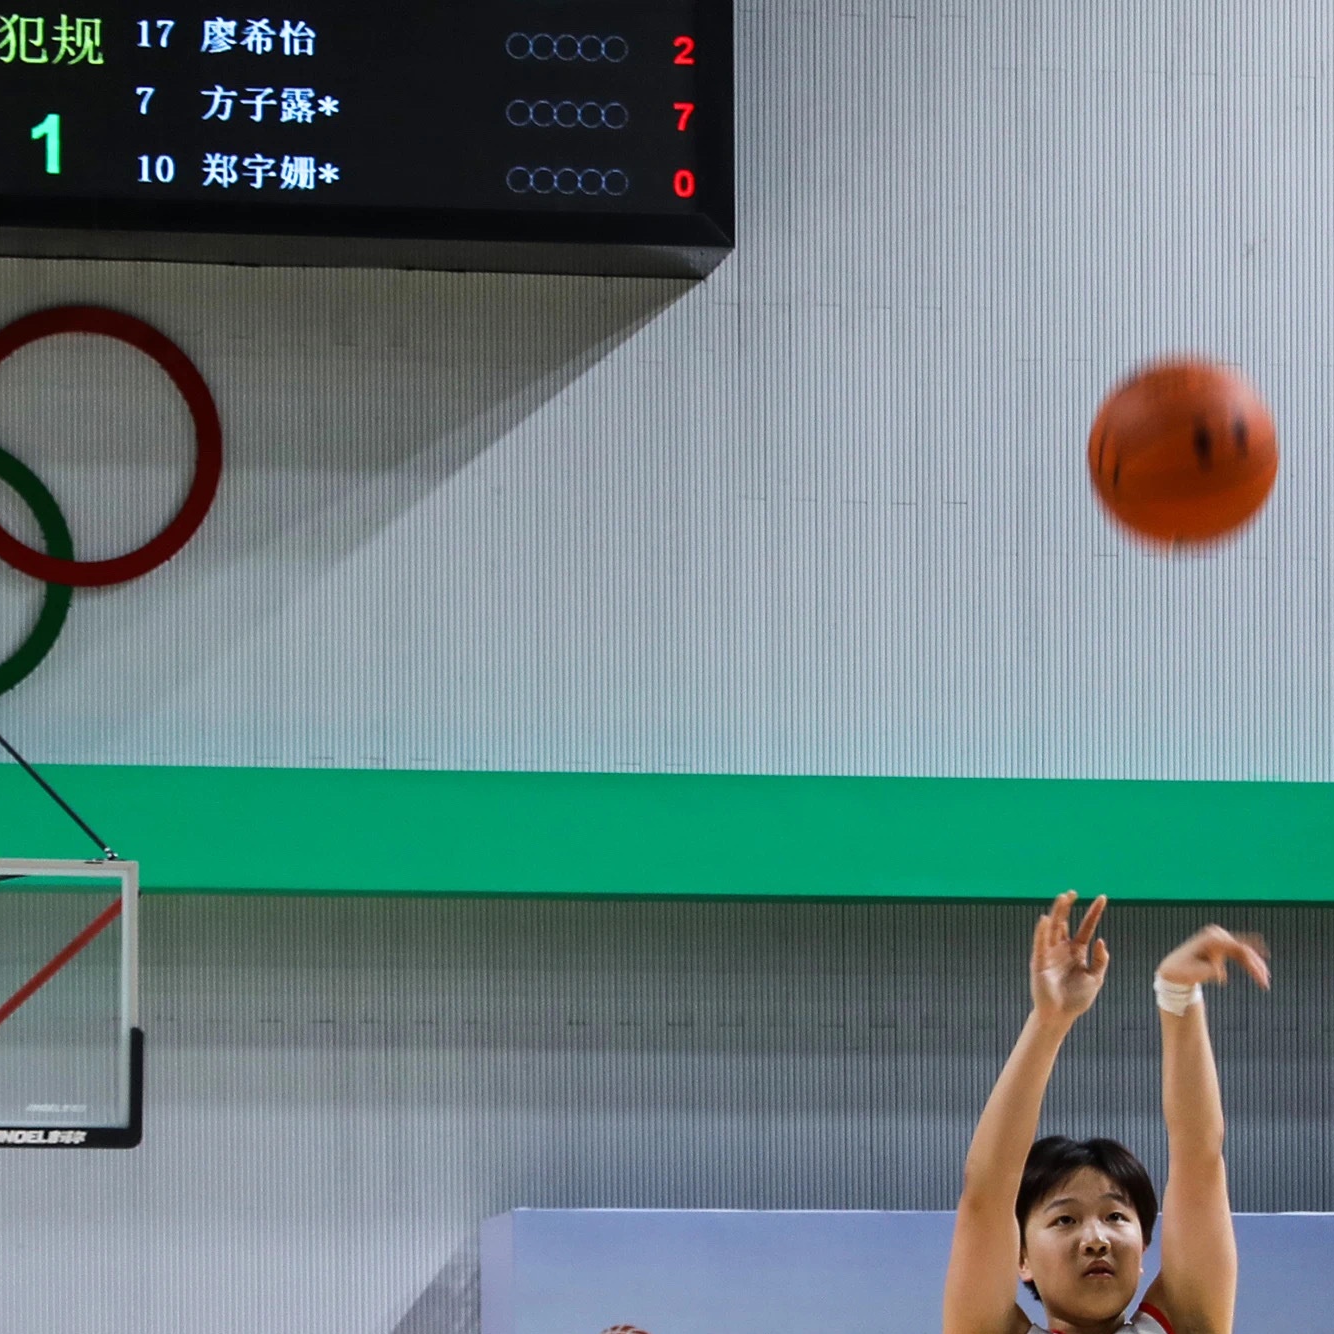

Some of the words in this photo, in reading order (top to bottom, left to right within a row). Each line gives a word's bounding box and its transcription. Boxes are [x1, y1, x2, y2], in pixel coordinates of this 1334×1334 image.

[136, 20, 175, 48] 17
[200, 17, 317, 56] 廖希怡
[673, 36, 695, 65] 2
[135, 87, 155, 114] 7
[673, 102, 695, 131] 7
[31, 113, 61, 174] 1
[137, 155, 175, 183] 10
[673, 169, 696, 198] 0
